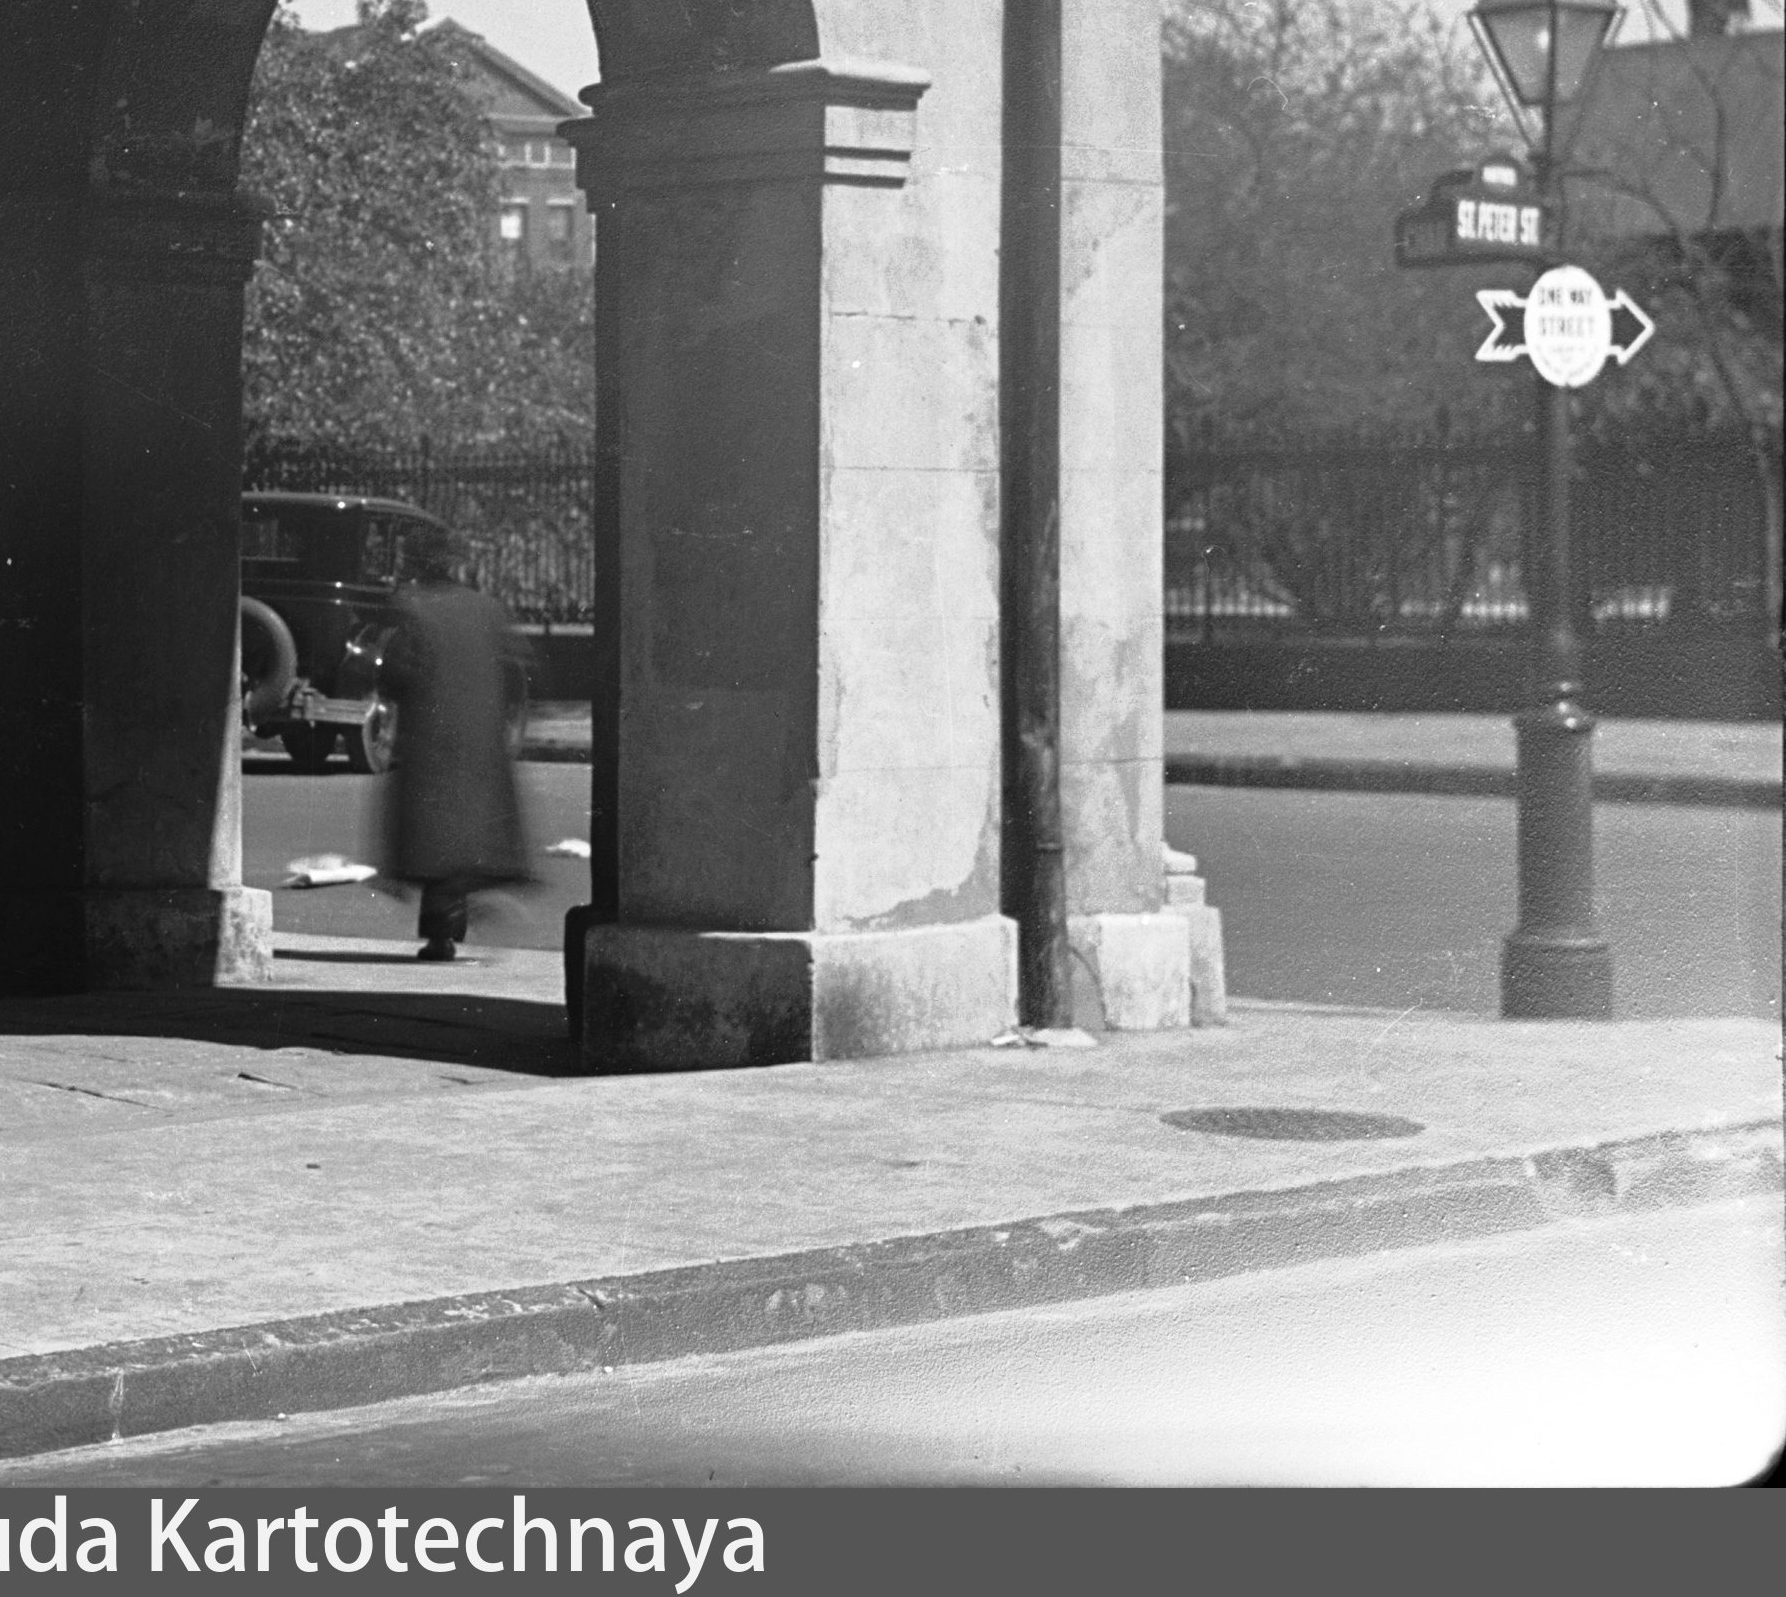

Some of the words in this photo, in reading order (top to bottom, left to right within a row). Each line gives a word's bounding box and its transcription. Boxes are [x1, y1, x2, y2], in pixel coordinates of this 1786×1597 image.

[1478, 202, 1518, 244] PETER
[1537, 285, 1563, 307] ONE
[1568, 287, 1593, 307] WAY
[1539, 315, 1595, 338] STREET
